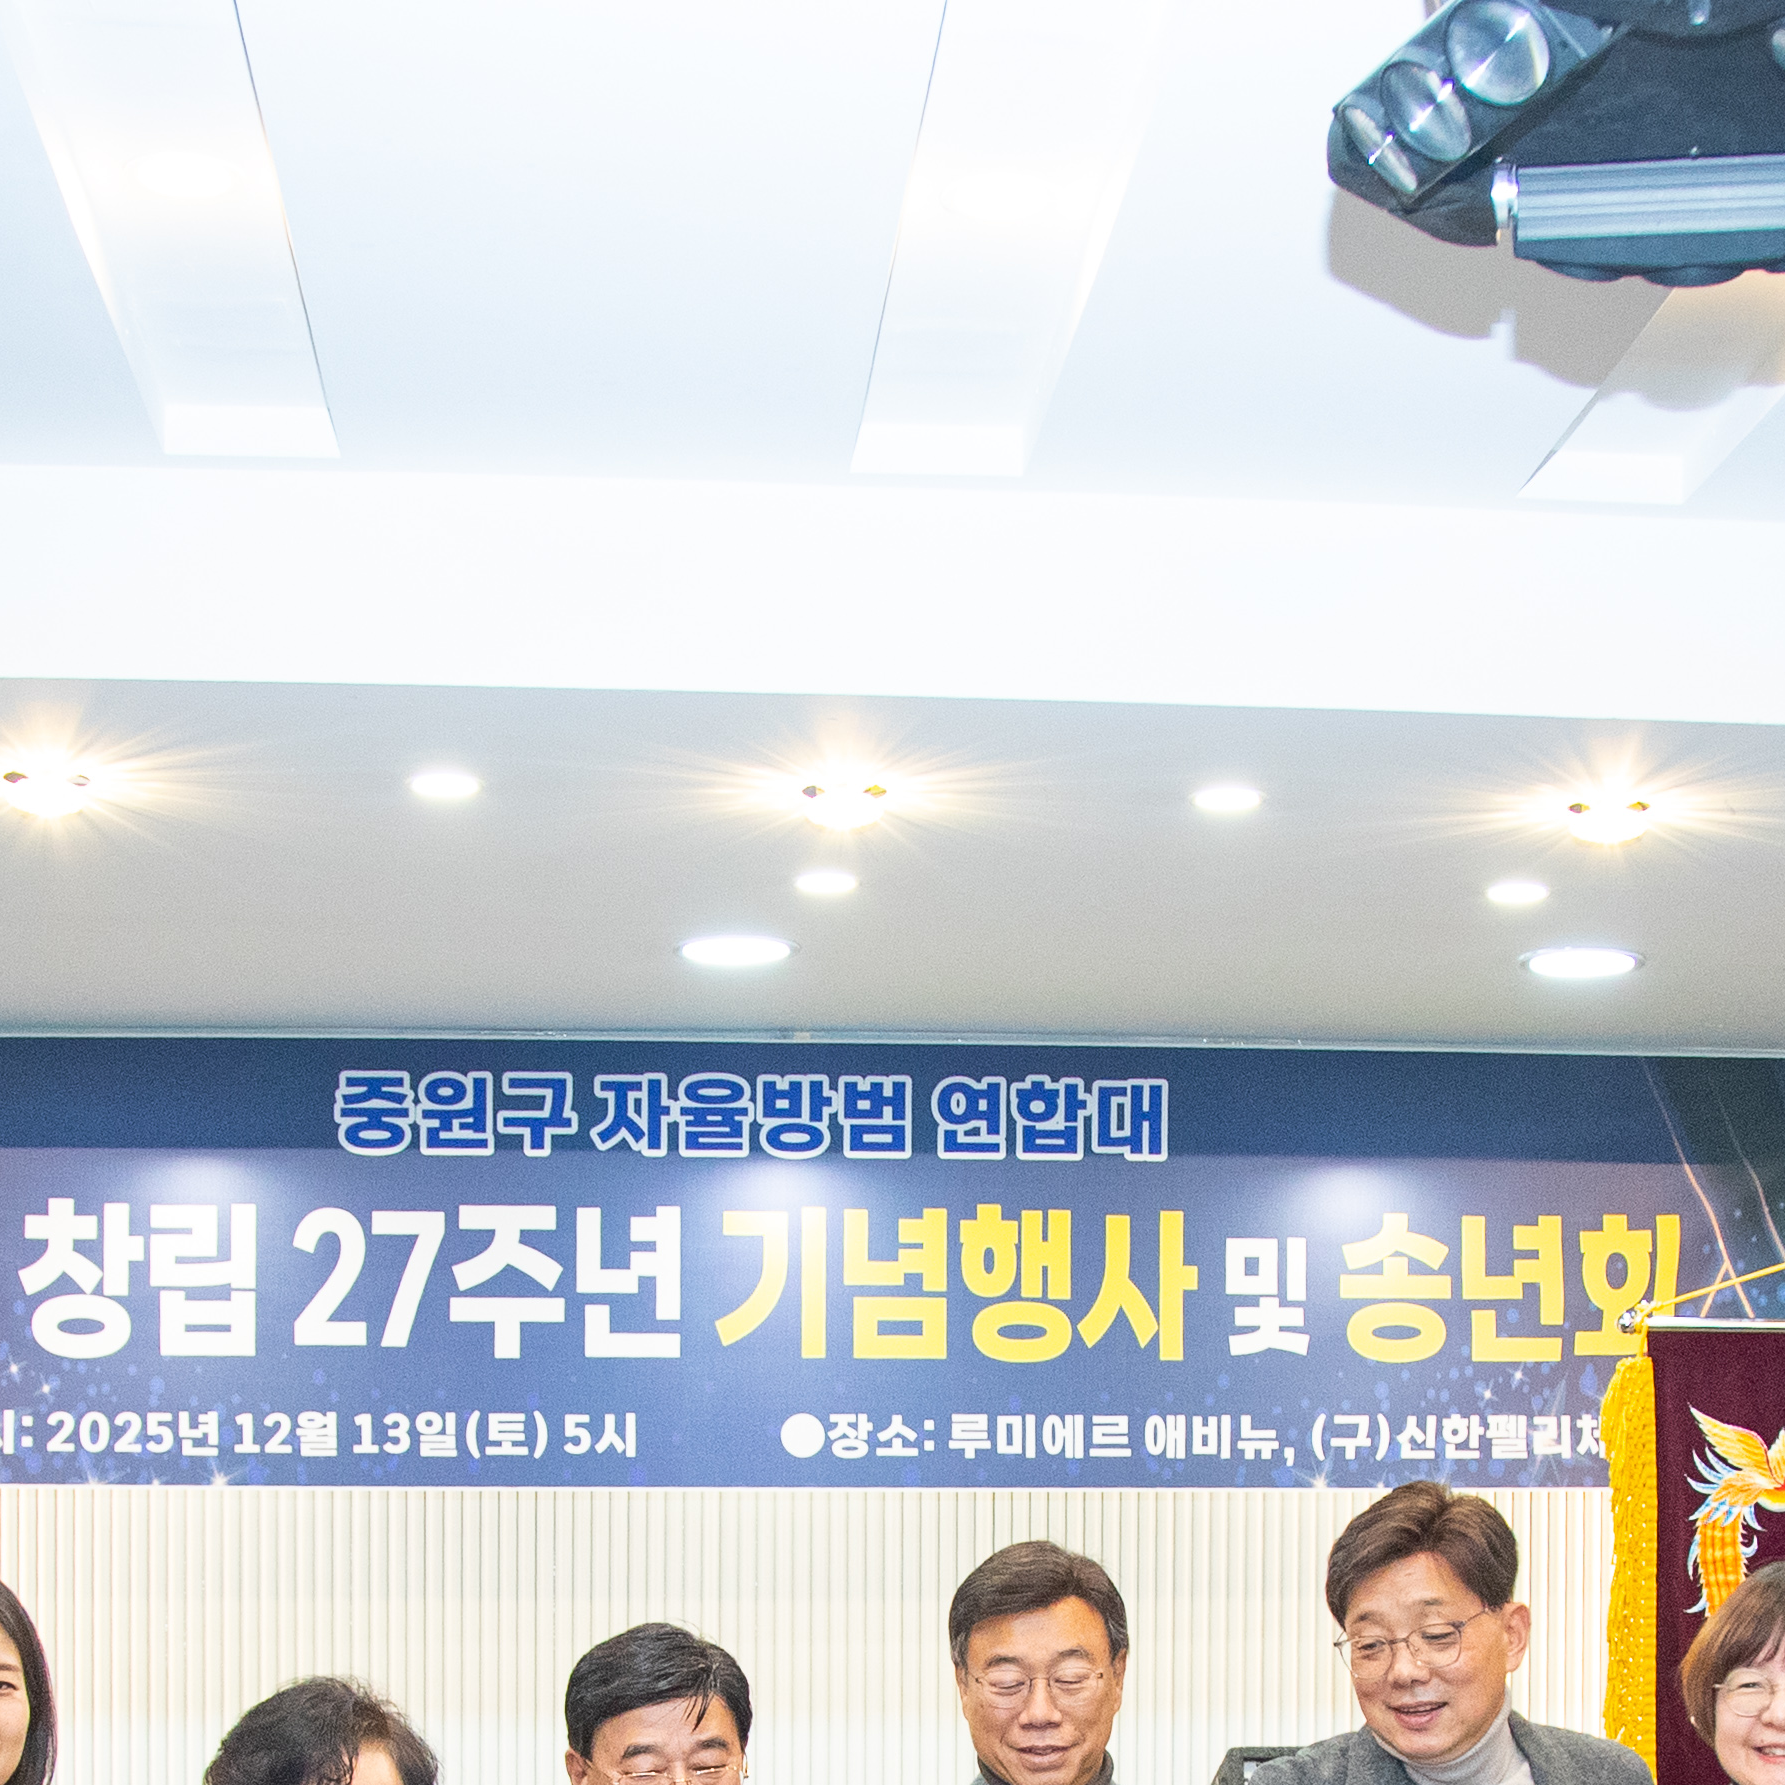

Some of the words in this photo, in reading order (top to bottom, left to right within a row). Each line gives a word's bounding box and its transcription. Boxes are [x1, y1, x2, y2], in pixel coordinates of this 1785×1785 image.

[335, 1069, 579, 1155] 중원구
[592, 1070, 912, 1160] 자율방범
[931, 1077, 1170, 1163] 연합대
[20, 1198, 256, 1361] 창립
[293, 1203, 681, 1361] 27주년
[715, 1203, 1198, 1363] 기념행사
[1224, 1236, 1310, 1358] 및
[1340, 1211, 1681, 1364] 송년회
[46, 1408, 219, 1457] 2025년
[233, 1408, 338, 1457] 12월
[353, 1408, 548, 1461] 13일(토)
[562, 1410, 637, 1459] 5시
[828, 1412, 935, 1458] 장소:
[949, 1412, 1132, 1460] 루미에르
[1145, 1412, 1295, 1467] 애비뉴,
